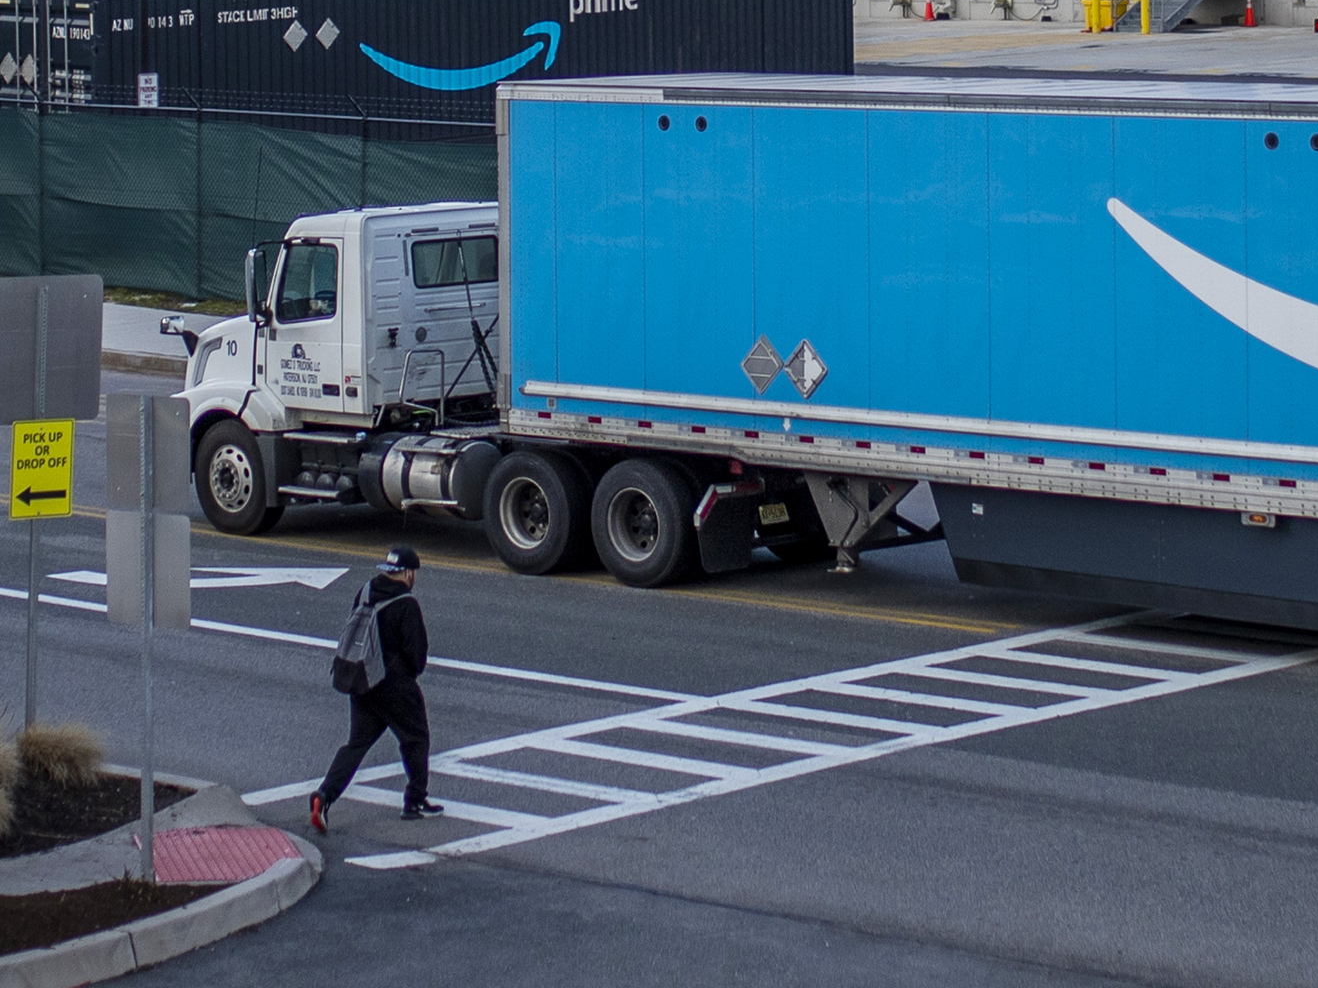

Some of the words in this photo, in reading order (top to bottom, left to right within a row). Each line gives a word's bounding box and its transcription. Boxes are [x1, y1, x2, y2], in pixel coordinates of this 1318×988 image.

[226, 340, 238, 357] 10
[23, 433, 45, 444] PICK
[48, 432, 63, 442] UP
[34, 445, 50, 455] OR
[16, 460, 45, 470] DROP
[47, 458, 67, 468] OFF
